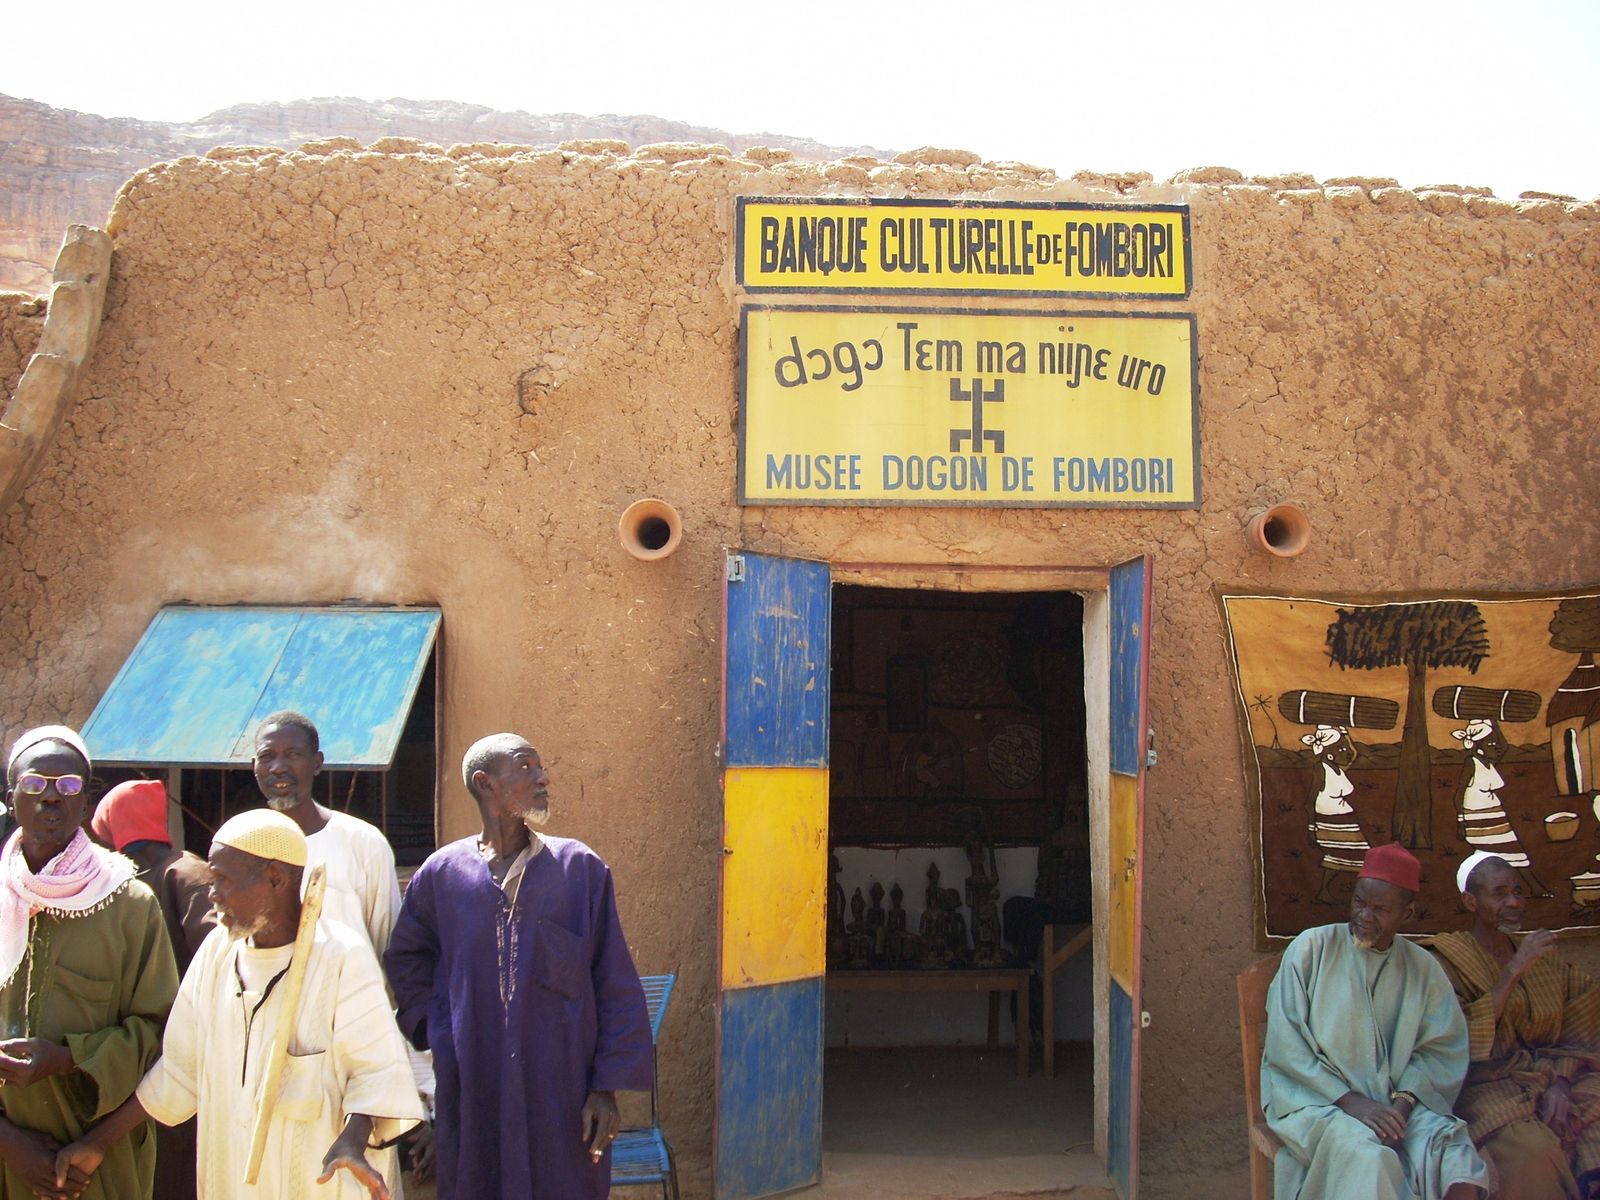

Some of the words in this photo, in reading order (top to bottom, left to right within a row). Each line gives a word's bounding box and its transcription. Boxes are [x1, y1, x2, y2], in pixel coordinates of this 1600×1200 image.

[760, 216, 866, 276] BANQUE
[880, 218, 1034, 275] CULTURELLE
[1036, 234, 1062, 265] DE
[1065, 222, 1173, 278] FOMBORI
[976, 340, 1026, 373] ma
[1117, 354, 1167, 396] uro
[766, 454, 861, 490] MUSEE
[882, 455, 987, 491] DOGON
[1001, 456, 1034, 492] DE
[1054, 457, 1174, 493] FOMBORI
